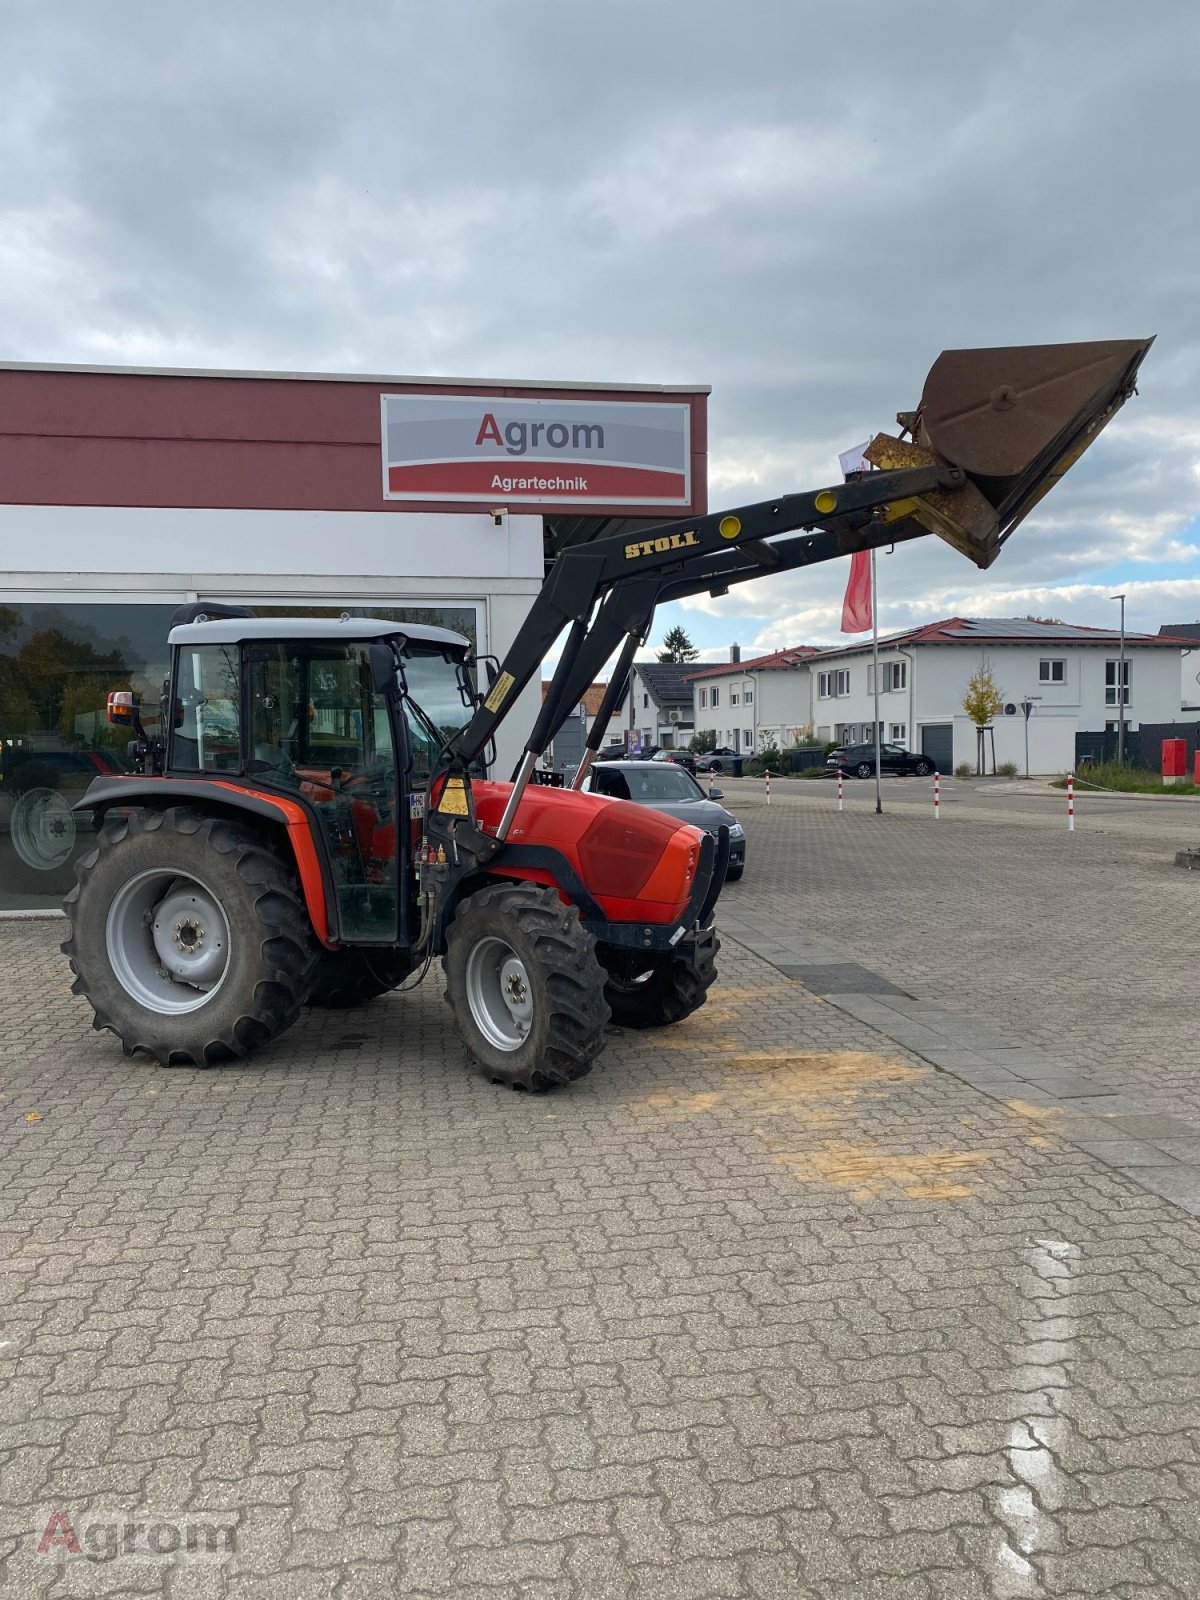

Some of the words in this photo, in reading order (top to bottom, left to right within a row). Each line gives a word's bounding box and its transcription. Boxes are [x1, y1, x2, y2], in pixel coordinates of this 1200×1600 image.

[475, 413, 605, 456] Agrom
[490, 474, 588, 492] Agrartechnik
[624, 531, 700, 560] STOLL
